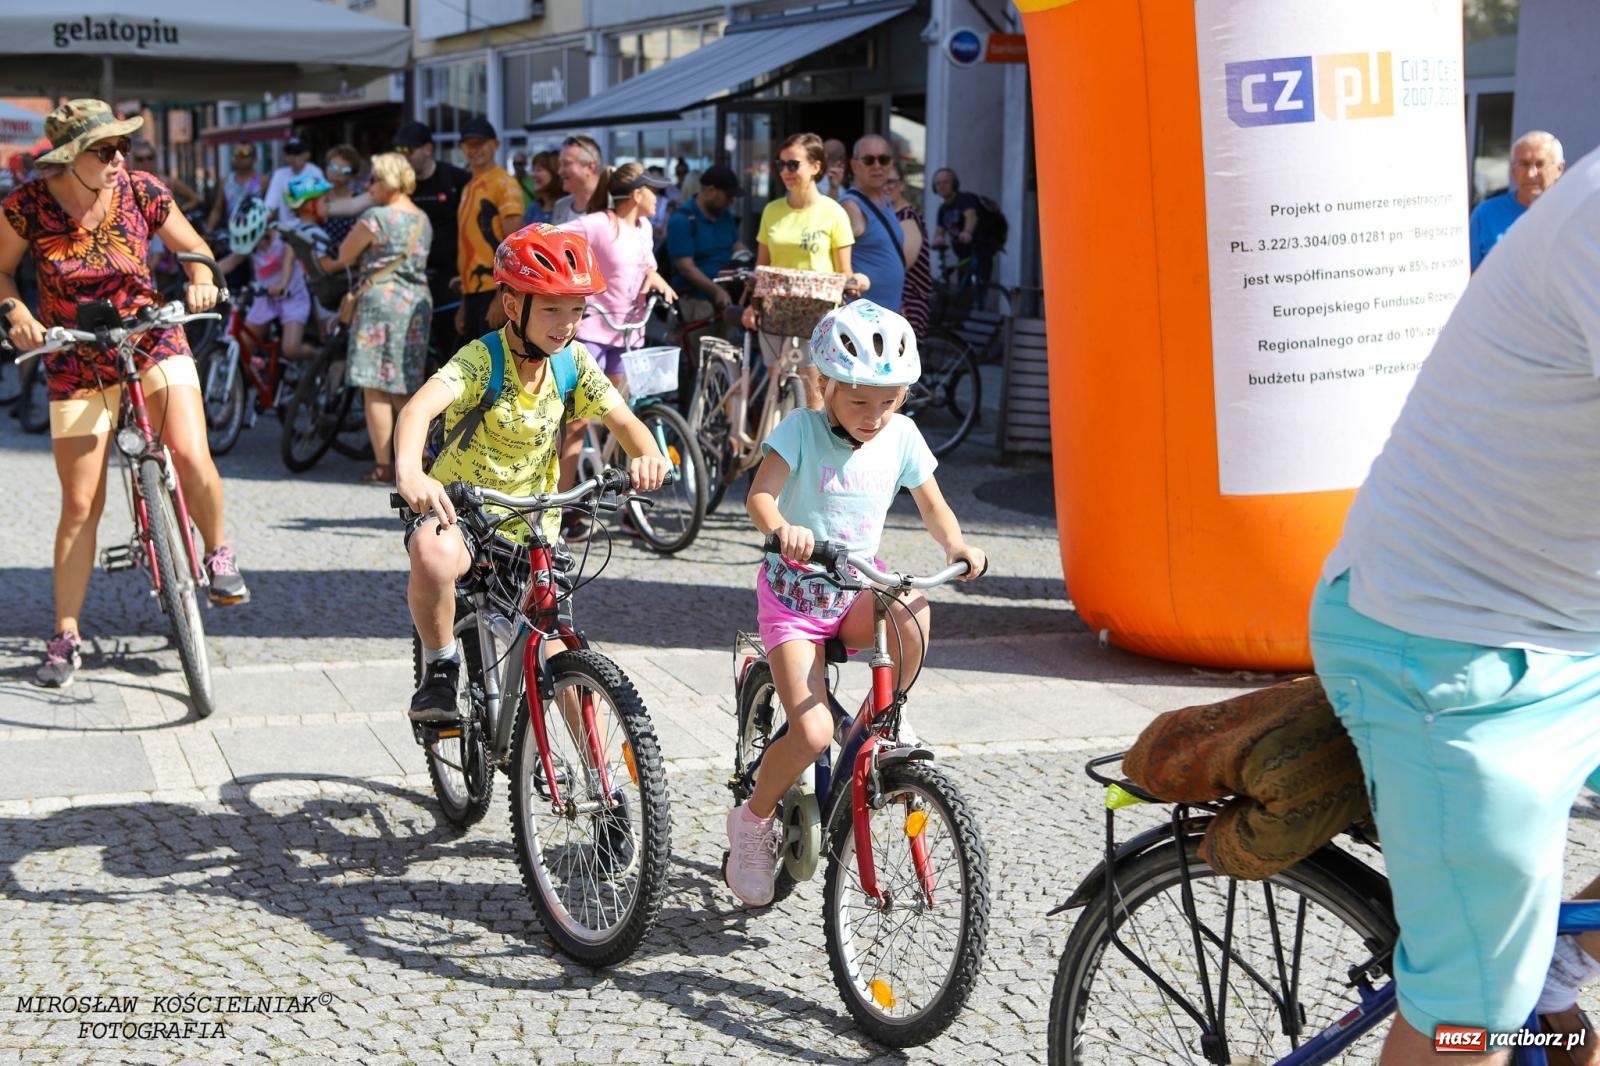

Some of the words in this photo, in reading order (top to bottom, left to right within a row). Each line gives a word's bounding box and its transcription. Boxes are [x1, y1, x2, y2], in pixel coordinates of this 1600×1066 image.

[53, 16, 178, 48] gelatopiu
[1270, 201, 1320, 218] Projekt
[1325, 203, 1333, 213] o
[1337, 197, 1389, 212] numerze
[1231, 240, 1253, 253] PL.
[1258, 231, 1386, 252] 3.22/3.304/09.01281
[1243, 273, 1270, 288] jest
[1274, 264, 1395, 285] współfinansowany
[1398, 264, 1406, 273] w
[1273, 298, 1370, 318] Europejskiego
[1374, 293, 1425, 309] Funduszu
[1258, 334, 1353, 353] Regionalnego
[1358, 332, 1383, 344] oraz
[1387, 329, 1401, 342] do
[1249, 369, 1305, 386] budżetu
[1309, 365, 1365, 384] państwa
[1369, 360, 1423, 376] "Przekrac
